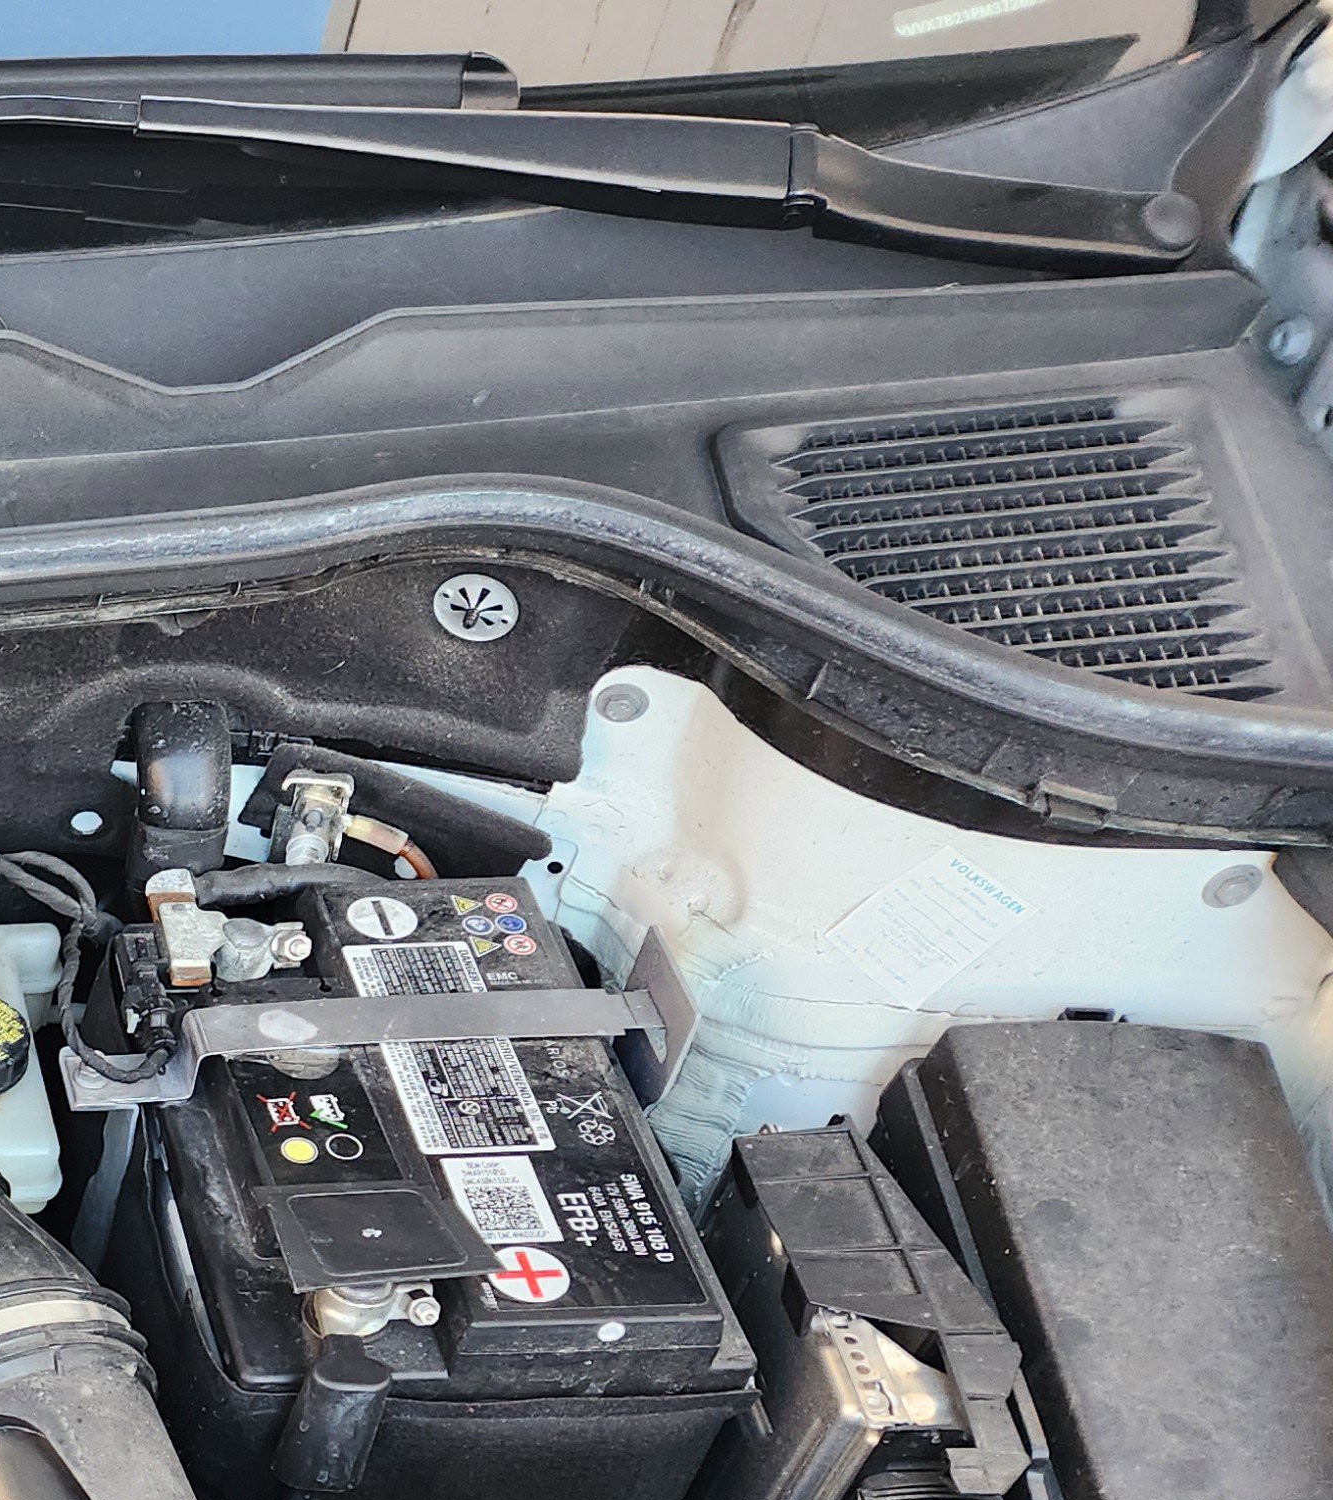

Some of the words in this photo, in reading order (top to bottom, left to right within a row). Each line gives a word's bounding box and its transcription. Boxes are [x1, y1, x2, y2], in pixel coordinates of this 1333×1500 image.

[950, 858, 1026, 915] VOLKSWAGEN
[486, 971, 519, 981] EMC
[619, 1173, 646, 1201] 5WA
[556, 1192, 600, 1247] EFB+
[633, 1202, 658, 1226] 915
[644, 1227, 670, 1251] 105
[655, 1252, 675, 1263] D
